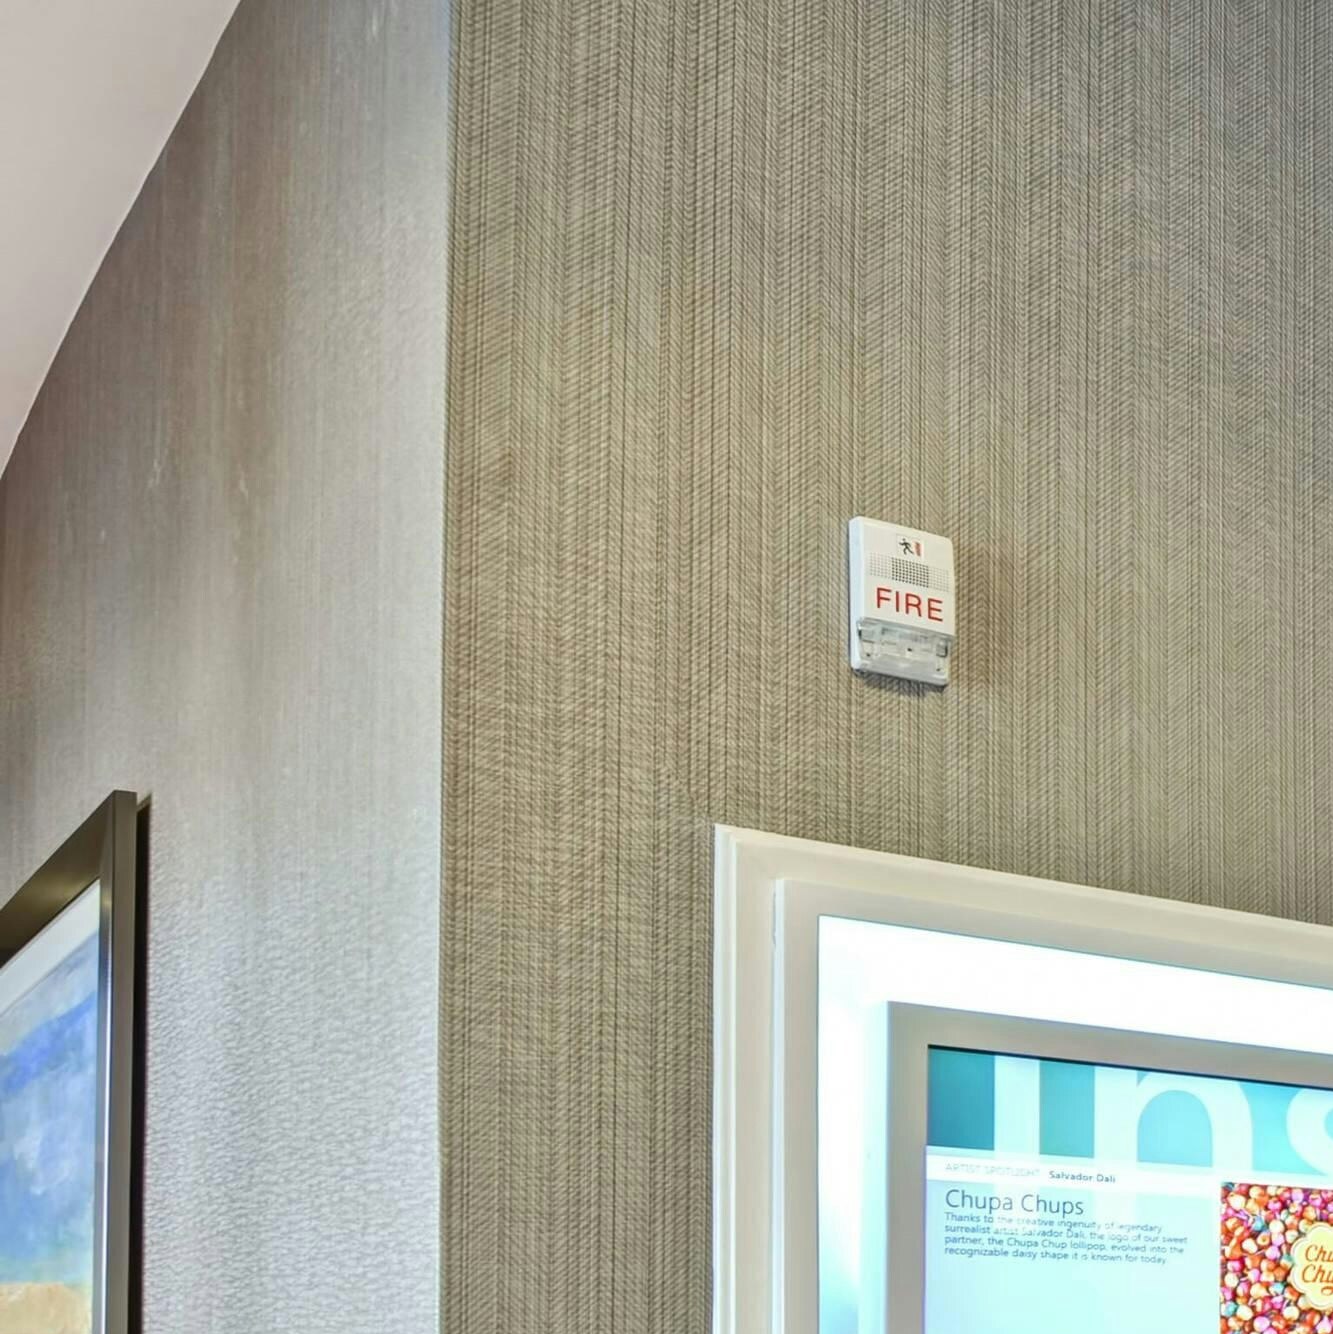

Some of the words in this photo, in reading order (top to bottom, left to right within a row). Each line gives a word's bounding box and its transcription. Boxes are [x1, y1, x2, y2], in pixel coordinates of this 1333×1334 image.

[876, 586, 944, 622] FIRE
[1049, 1170, 1093, 1182] Salvador
[1096, 1173, 1116, 1184] Dali
[945, 1188, 1013, 1214] Chupa
[1021, 1194, 1084, 1218] Chups
[944, 1212, 981, 1223] Thanks
[984, 1215, 993, 1223] to
[1016, 1217, 1055, 1227] creative
[1057, 1218, 1102, 1230] ingenuity
[1105, 1222, 1115, 1230] of
[944, 1223, 991, 1235] surrealist
[1022, 1227, 1064, 1238] Salvador
[1089, 1231, 1105, 1240] the
[1108, 1232, 1129, 1243] logo
[1132, 1233, 1142, 1242] of
[1144, 1235, 1160, 1243] our
[1162, 1236, 1188, 1244] sweet
[944, 1246, 1009, 1258] recognizable
[1012, 1249, 1038, 1260] daisy
[1040, 1250, 1069, 1260] shape
[1091, 1252, 1122, 1261] known
[1125, 1254, 1137, 1262] for
[987, 1236, 1004, 1246] the
[1007, 1237, 1039, 1248] Chupa
[1041, 1239, 1067, 1250] Chup
[1111, 1243, 1146, 1252] evolved
[1150, 1245, 1167, 1253] into
[1170, 1246, 1184, 1254] the
